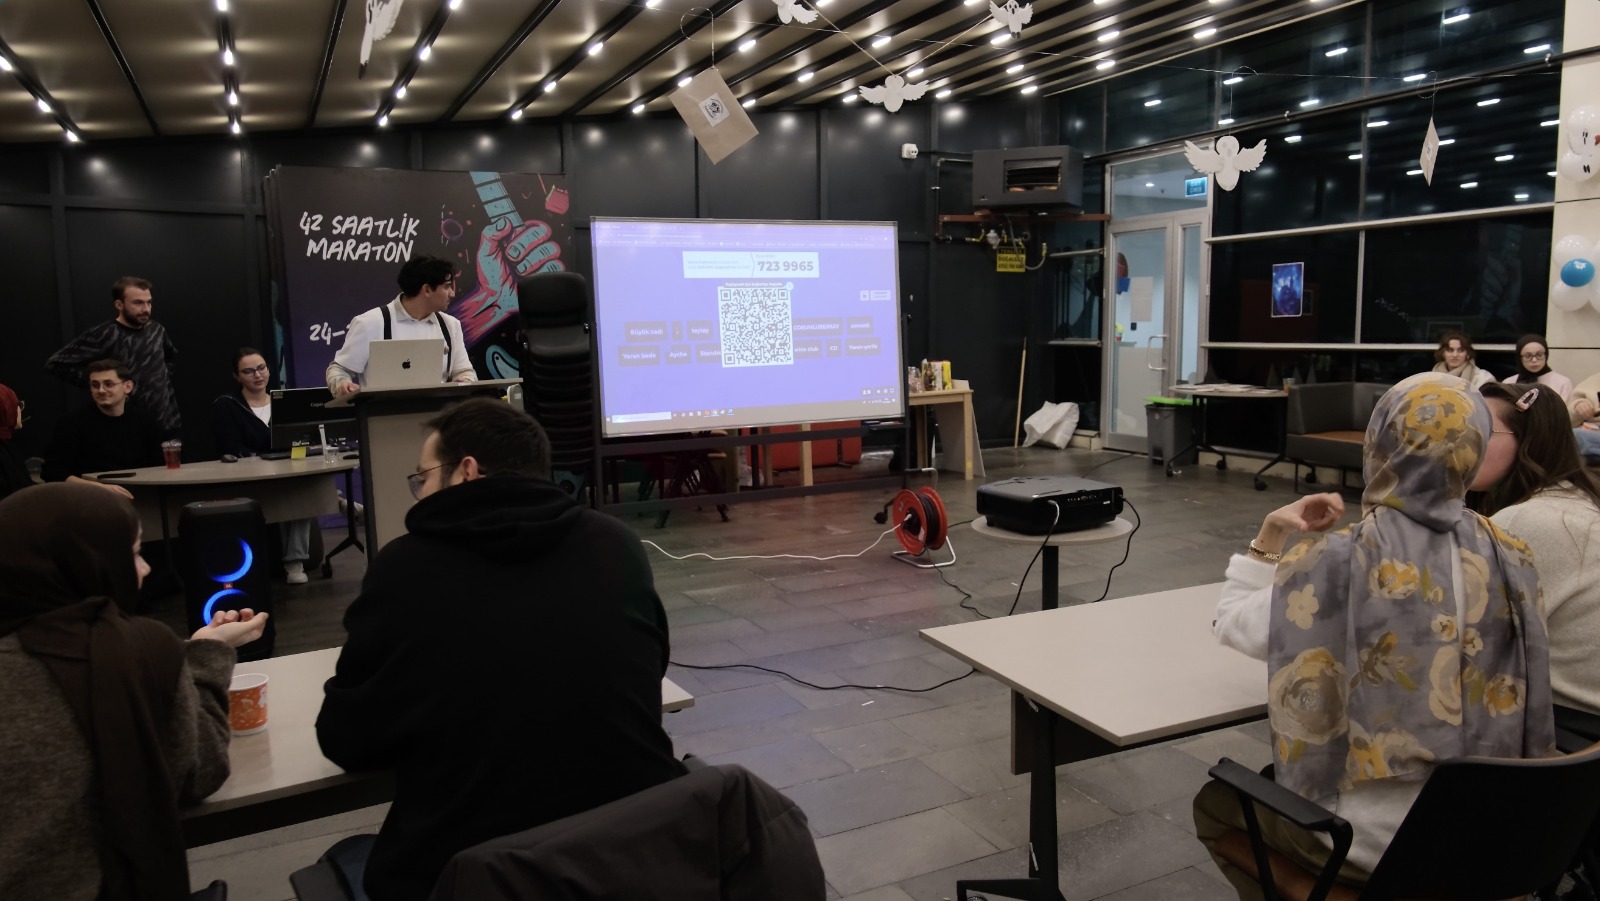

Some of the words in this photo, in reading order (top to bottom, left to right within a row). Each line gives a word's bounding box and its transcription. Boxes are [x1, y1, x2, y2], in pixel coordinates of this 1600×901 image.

[300, 211, 323, 235] 42
[332, 213, 420, 242] SAATLİK
[306, 237, 413, 263] MARATON
[757, 261, 780, 271] 723
[782, 261, 814, 271] 9965
[309, 322, 351, 345] 24-
